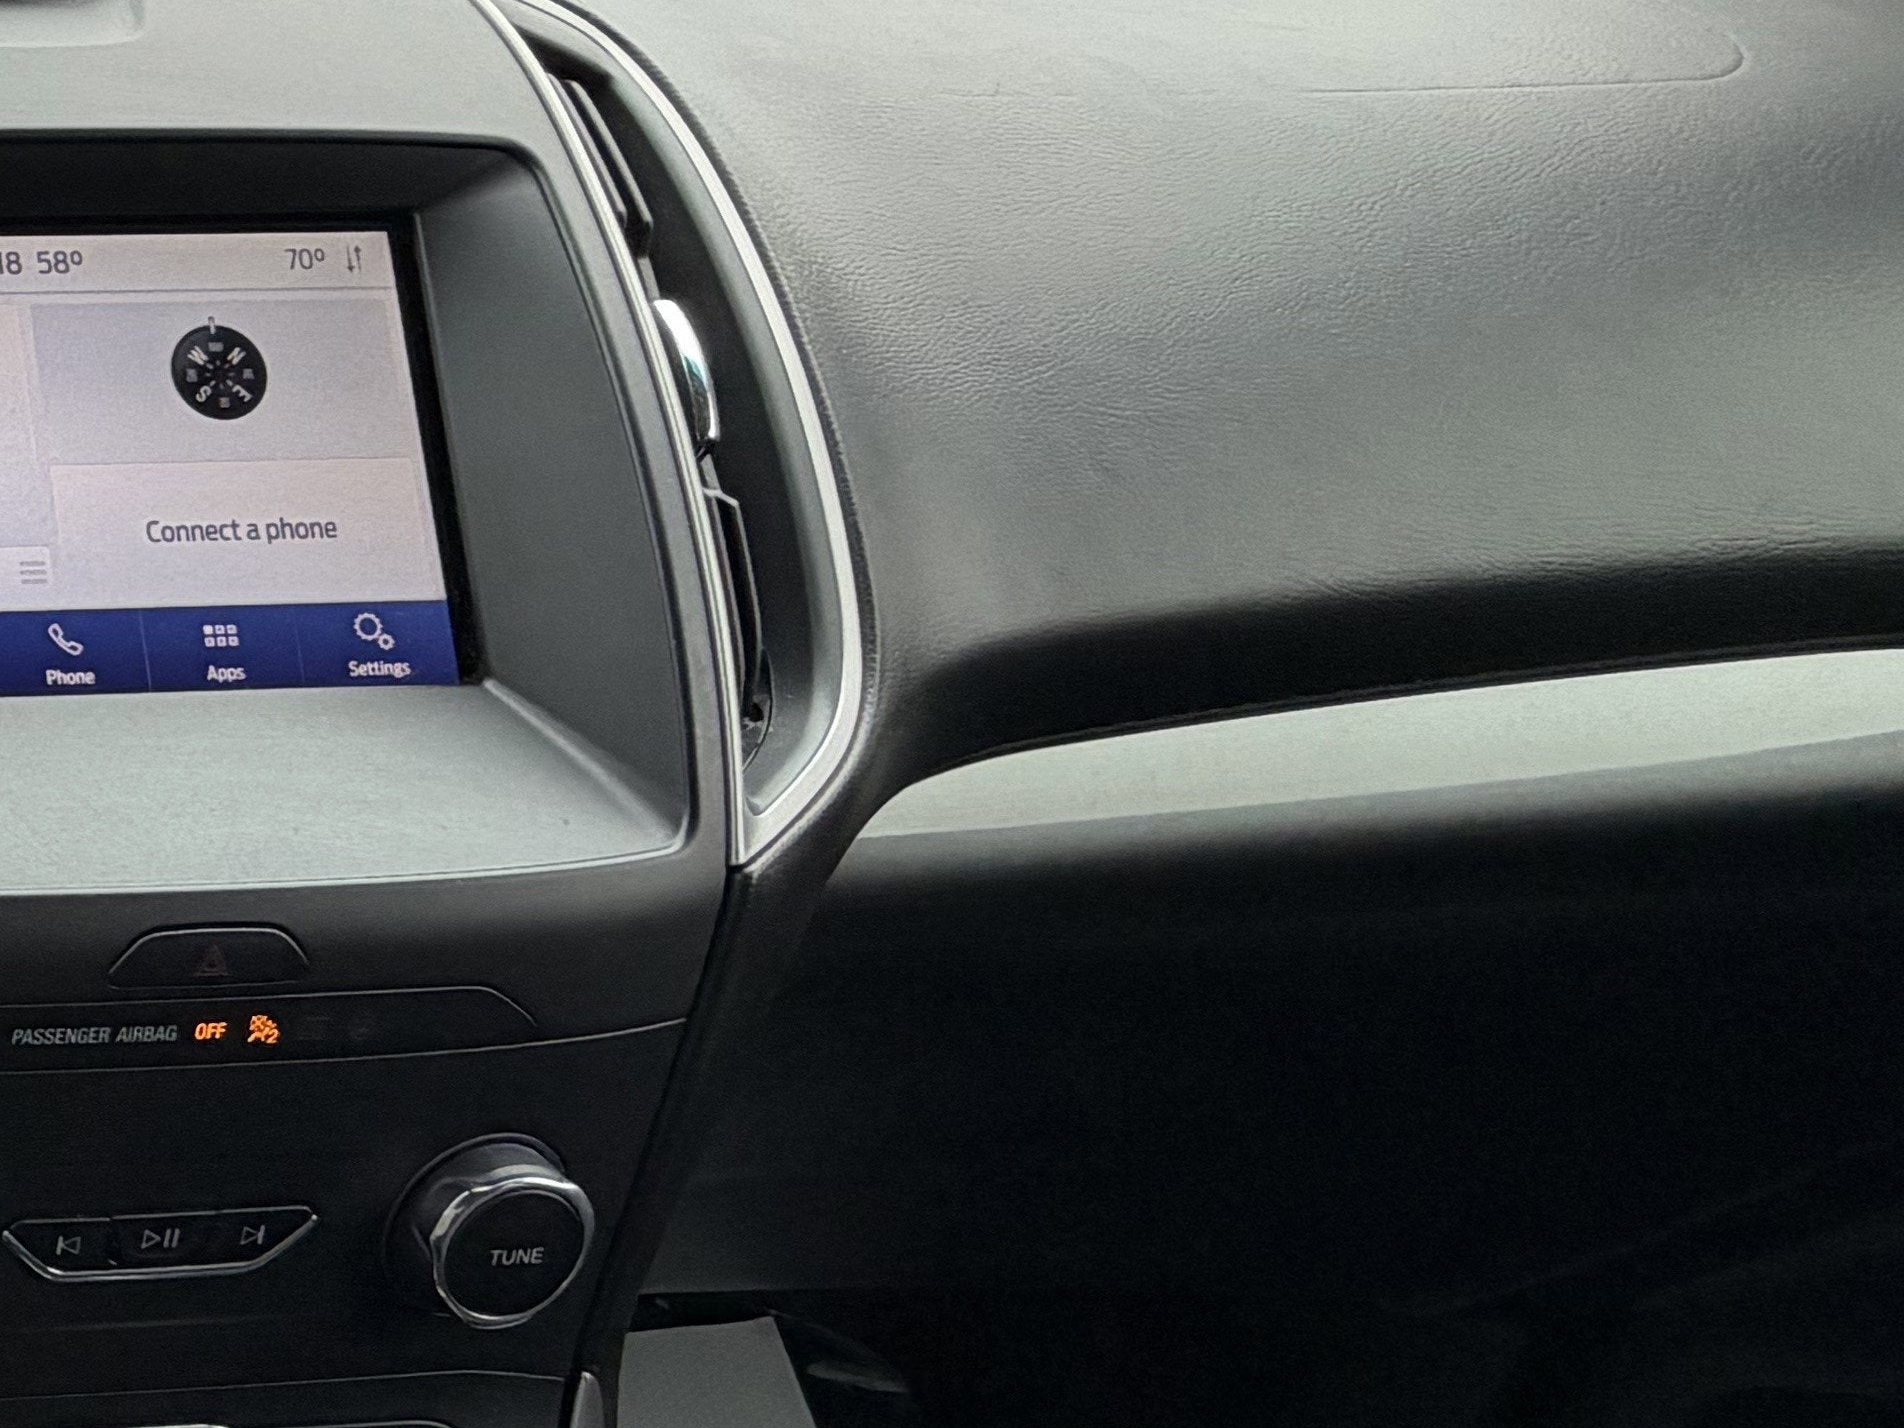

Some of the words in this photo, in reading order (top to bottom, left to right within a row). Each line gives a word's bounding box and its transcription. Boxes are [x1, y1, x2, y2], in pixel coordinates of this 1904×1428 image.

[36, 250, 83, 277] 58°
[285, 247, 325, 272] 70°
[146, 517, 243, 543] Connect
[247, 523, 260, 542] a
[266, 516, 338, 546] phone
[45, 667, 96, 687] Phone
[206, 663, 247, 684] Apps
[348, 658, 411, 680] Settings
[11, 1026, 110, 1045] PASSENGER
[115, 1025, 178, 1043] AIRBAG
[194, 1022, 228, 1041] OFF
[489, 1247, 545, 1267] TUNE
